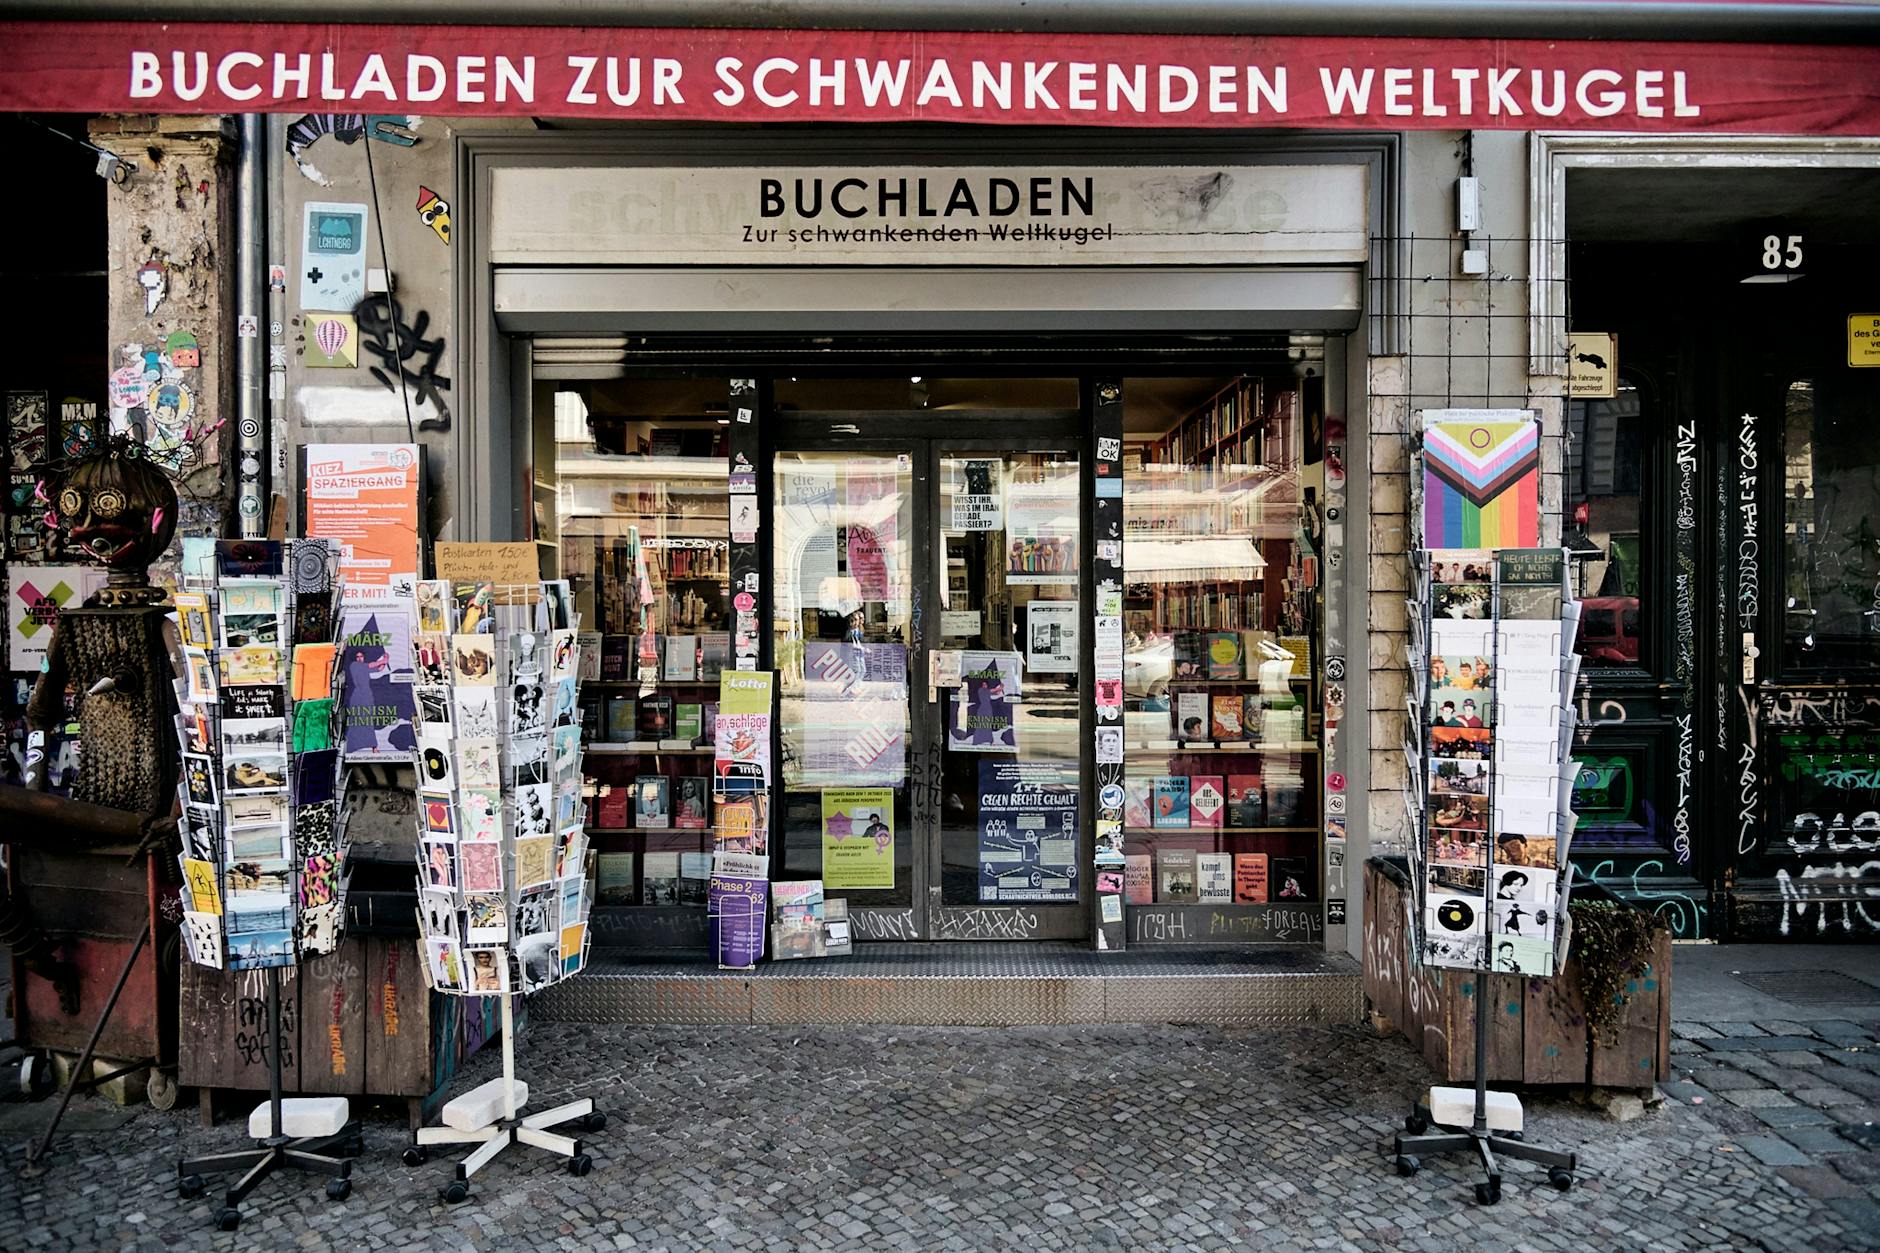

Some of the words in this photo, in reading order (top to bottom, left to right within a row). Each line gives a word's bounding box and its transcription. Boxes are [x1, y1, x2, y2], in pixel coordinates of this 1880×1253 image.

[131, 52, 534, 102] BUCHLADEN
[567, 57, 684, 106] ZUR
[714, 58, 1287, 113] SCHWANKENDEN
[1320, 68, 1699, 117] WELTKUGEL
[761, 178, 1092, 218] BUCHLADEN
[743, 225, 779, 243] Zur
[789, 224, 979, 243] schwankenden
[988, 223, 1113, 246] Weltkugel
[1762, 235, 1803, 269] 85
[1578, 374, 1603, 382] Fahrzeuge
[1101, 448, 1117, 460] OK
[312, 462, 342, 476] KIEZ
[314, 475, 403, 489] SPAZIERGANG
[792, 475, 815, 486] die
[954, 496, 977, 504] WISST
[954, 504, 970, 512] WAS
[982, 504, 1000, 512] IRAN
[954, 520, 993, 528] PASSIERT?
[362, 588, 387, 598] MIT!
[716, 714, 768, 731] an.schläge
[982, 793, 1009, 806] GEGEN
[1010, 793, 1042, 806] RECHTE
[1043, 793, 1076, 806] GEWALT
[1201, 861, 1221, 872] kampf
[711, 878, 744, 893] Phase
[744, 882, 753, 893] 2
[751, 893, 764, 904] 62
